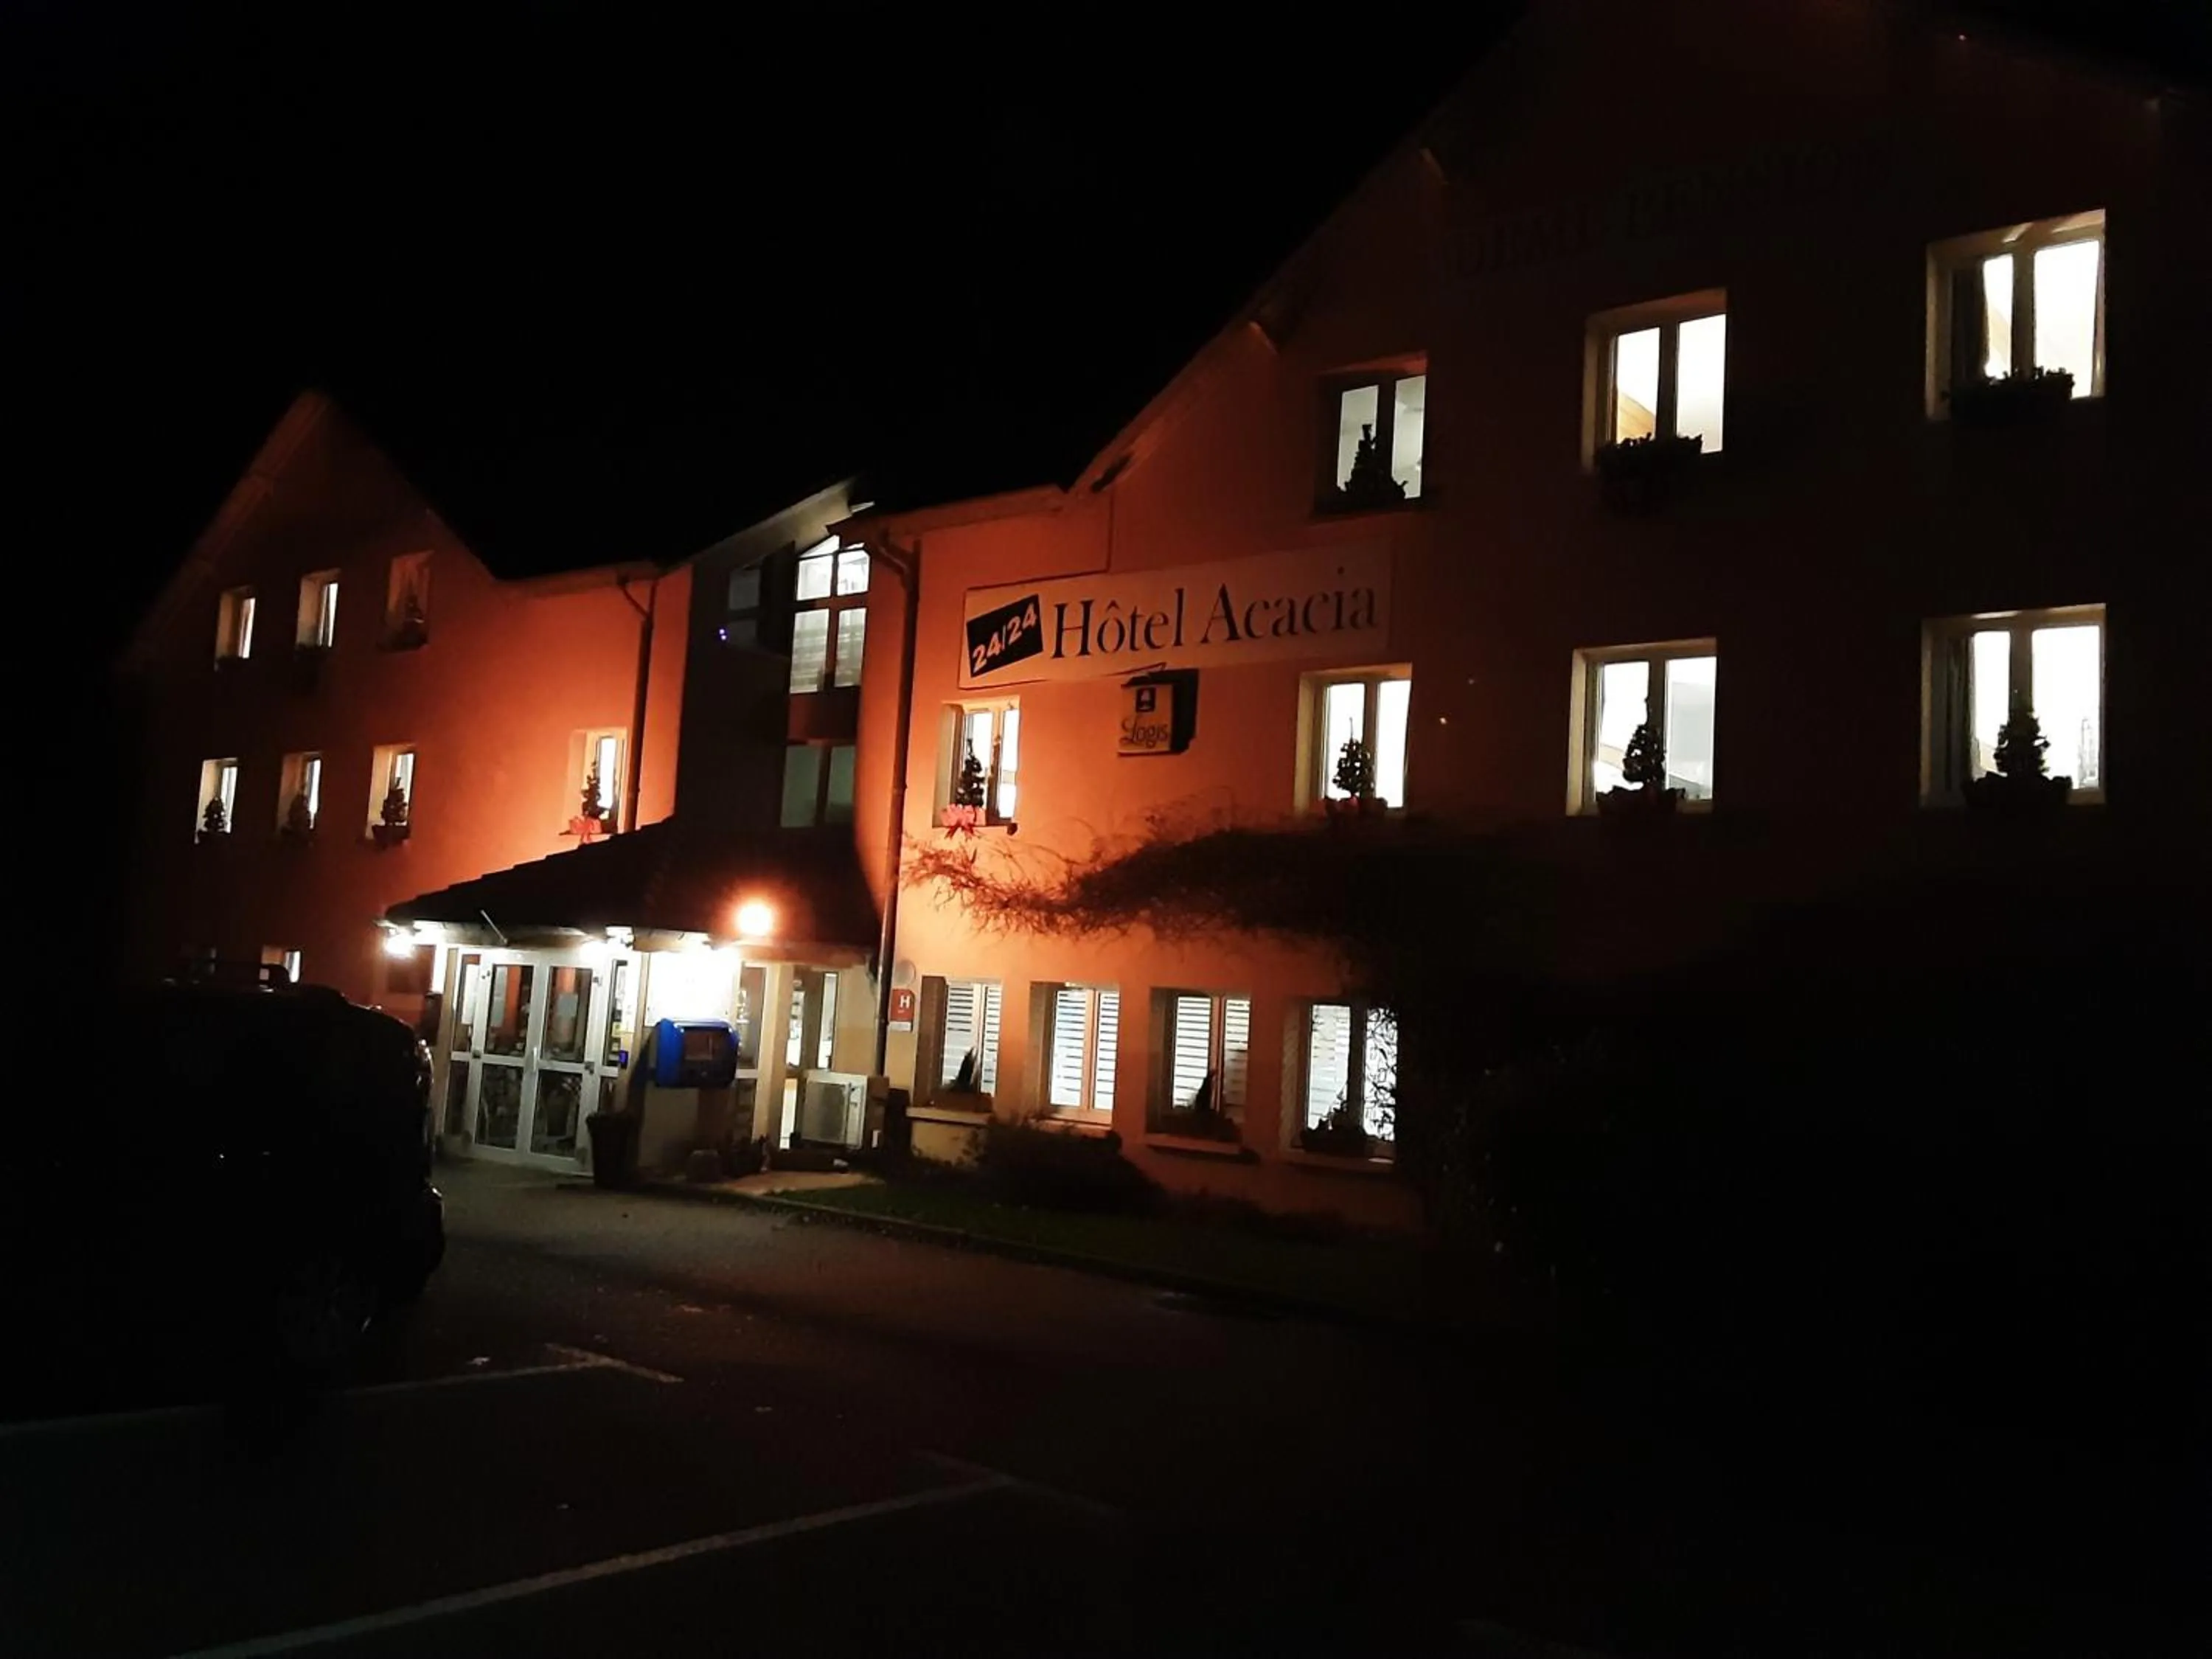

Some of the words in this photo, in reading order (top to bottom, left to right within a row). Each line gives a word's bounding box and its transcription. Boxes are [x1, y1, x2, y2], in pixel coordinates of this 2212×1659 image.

[972, 602, 1037, 674] 24/24
[1051, 588, 1184, 659] Hôtel
[1200, 567, 1377, 644] Acacia
[1119, 714, 1169, 749] Logis
[899, 995, 911, 1009] H
